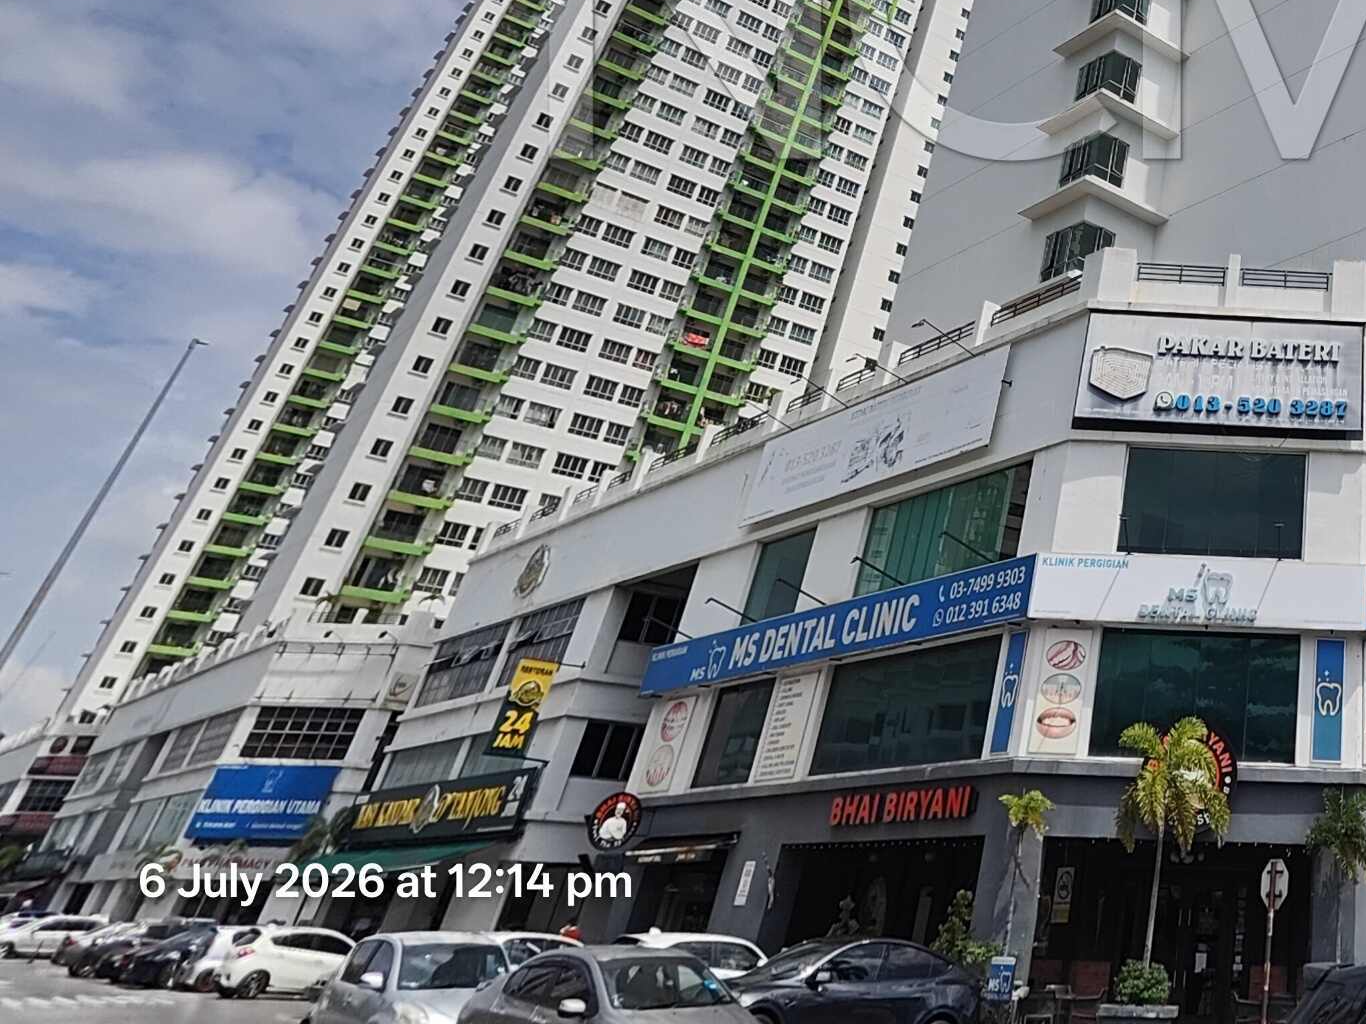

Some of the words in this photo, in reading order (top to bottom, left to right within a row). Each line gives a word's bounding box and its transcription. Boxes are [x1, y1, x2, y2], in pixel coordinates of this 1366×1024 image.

[1157, 335, 1243, 359] PAKAR
[1250, 340, 1341, 363] BATERI
[1290, 398, 1347, 419] 3287
[1042, 556, 1074, 568] KLINIK
[1077, 558, 1129, 570] PERGIGIAN
[950, 571, 995, 599] 03-7499
[996, 566, 1026, 591] 9303
[1167, 587, 1198, 603] MS
[945, 606, 966, 624] 012
[967, 600, 990, 620] 391
[991, 592, 1021, 615] 6348
[1137, 604, 1201, 620] DENTAL
[1204, 608, 1258, 623] CLINIC
[729, 633, 759, 671] MS
[758, 613, 834, 664] DENTAL
[841, 593, 920, 643] CLINIC
[690, 666, 706, 682] MS
[499, 709, 534, 734] 24
[492, 732, 525, 749] JAM
[286, 799, 322, 814] UTAMA
[830, 792, 881, 826] BHAI
[883, 785, 972, 823] BIRYANI
